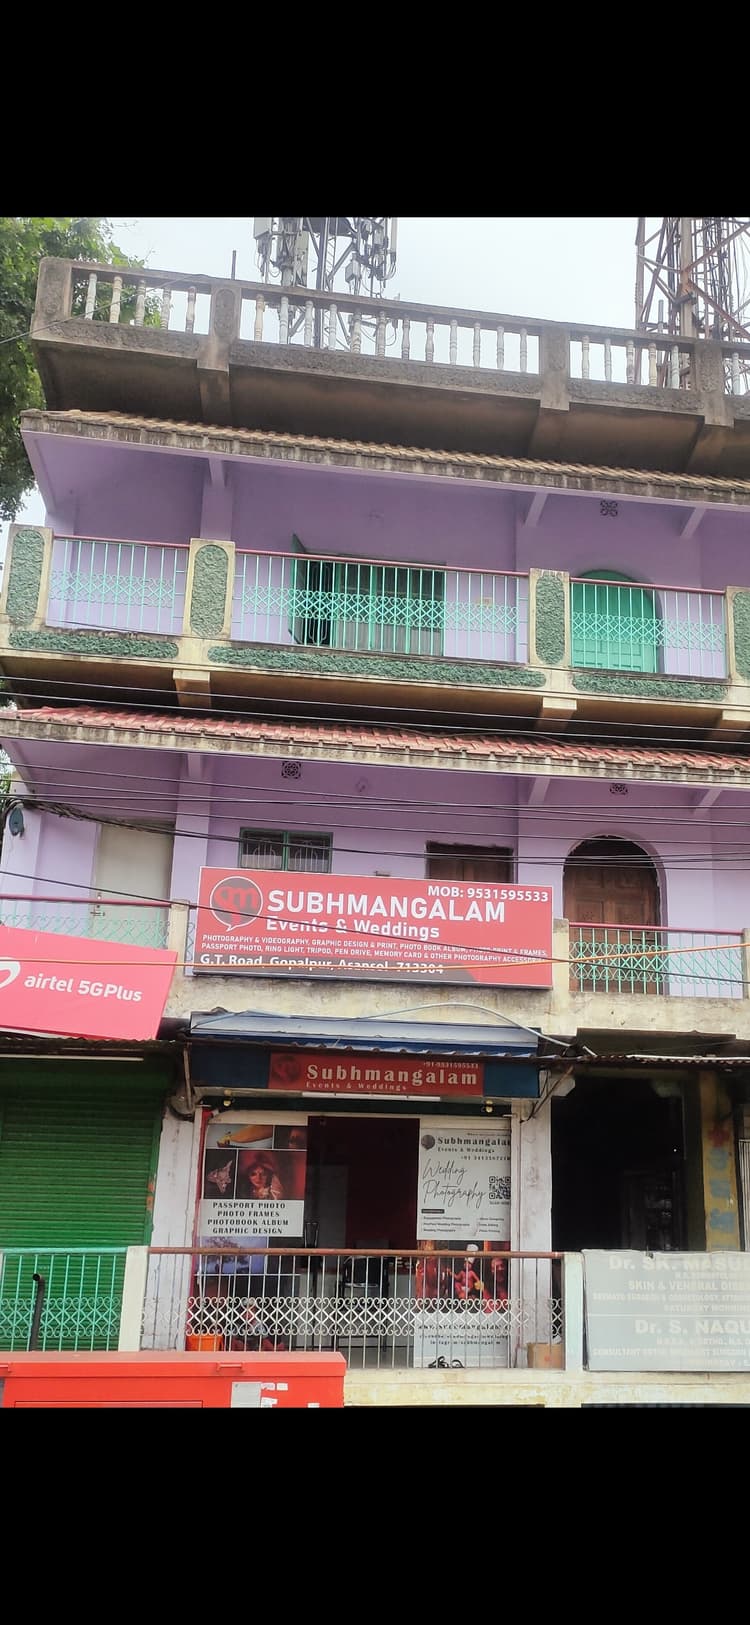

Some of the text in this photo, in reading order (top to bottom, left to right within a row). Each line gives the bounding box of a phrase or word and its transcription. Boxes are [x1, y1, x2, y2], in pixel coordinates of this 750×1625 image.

[428, 885, 549, 902] MOB: 9531595533
[267, 889, 505, 923] SUBHMANGALAM
[266, 916, 440, 941] Events & Weddings
[203, 934, 253, 944] PHOTOGRAPHY
[261, 937, 310, 946] VIDEOGRAPHY,
[311, 939, 342, 947] GRAPHIC
[200, 953, 225, 965] G.T.
[201, 943, 237, 951] PASSPORT
[239, 944, 264, 952] PHOTO,
[265, 945, 282, 953] RING
[283, 946, 305, 954] LIGHT,
[430, 952, 452, 960] OTHER
[453, 953, 501, 963] PHOTOGRAPHY
[24, 973, 74, 993] airtel
[306, 1064, 477, 1086] Subhmangalam
[358, 1082, 407, 1091] Weddings
[422, 1158, 468, 1186] Wedding
[422, 1179, 487, 1209] Photography
[609, 1254, 636, 1270] Dr.
[628, 1280, 655, 1291] SKIN
[635, 1319, 662, 1334] Dr.
[669, 1319, 688, 1335] S.
